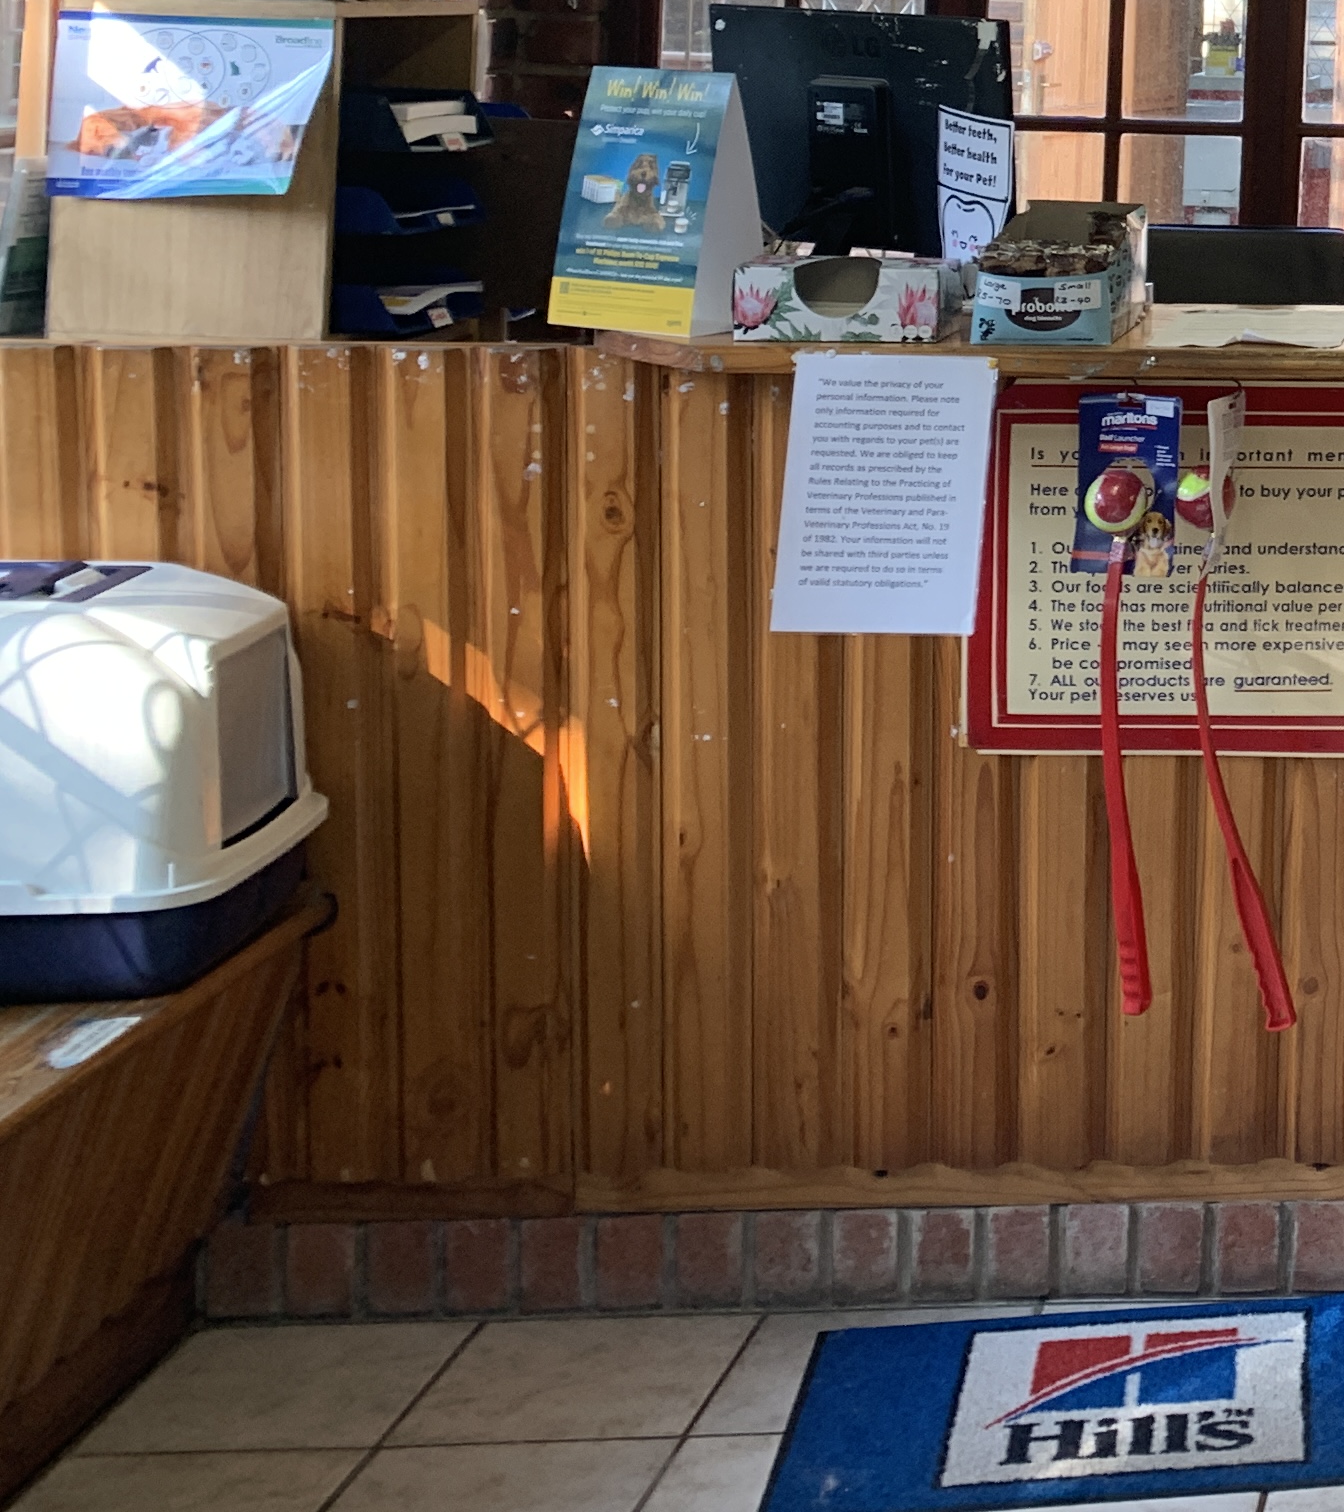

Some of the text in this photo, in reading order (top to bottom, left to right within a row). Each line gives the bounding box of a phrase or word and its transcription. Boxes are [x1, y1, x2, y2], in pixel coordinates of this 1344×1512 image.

[968, 125, 997, 143] teeth,
[967, 147, 997, 164] health
[955, 171, 974, 181] your
[976, 173, 997, 187] Pet!
[1030, 447, 1045, 460] Is
[1030, 483, 1069, 497] Here
[1239, 485, 1256, 498] to
[1260, 484, 1292, 500] buy
[1296, 485, 1333, 499] your
[999, 1410, 1255, 1466] Hill's
